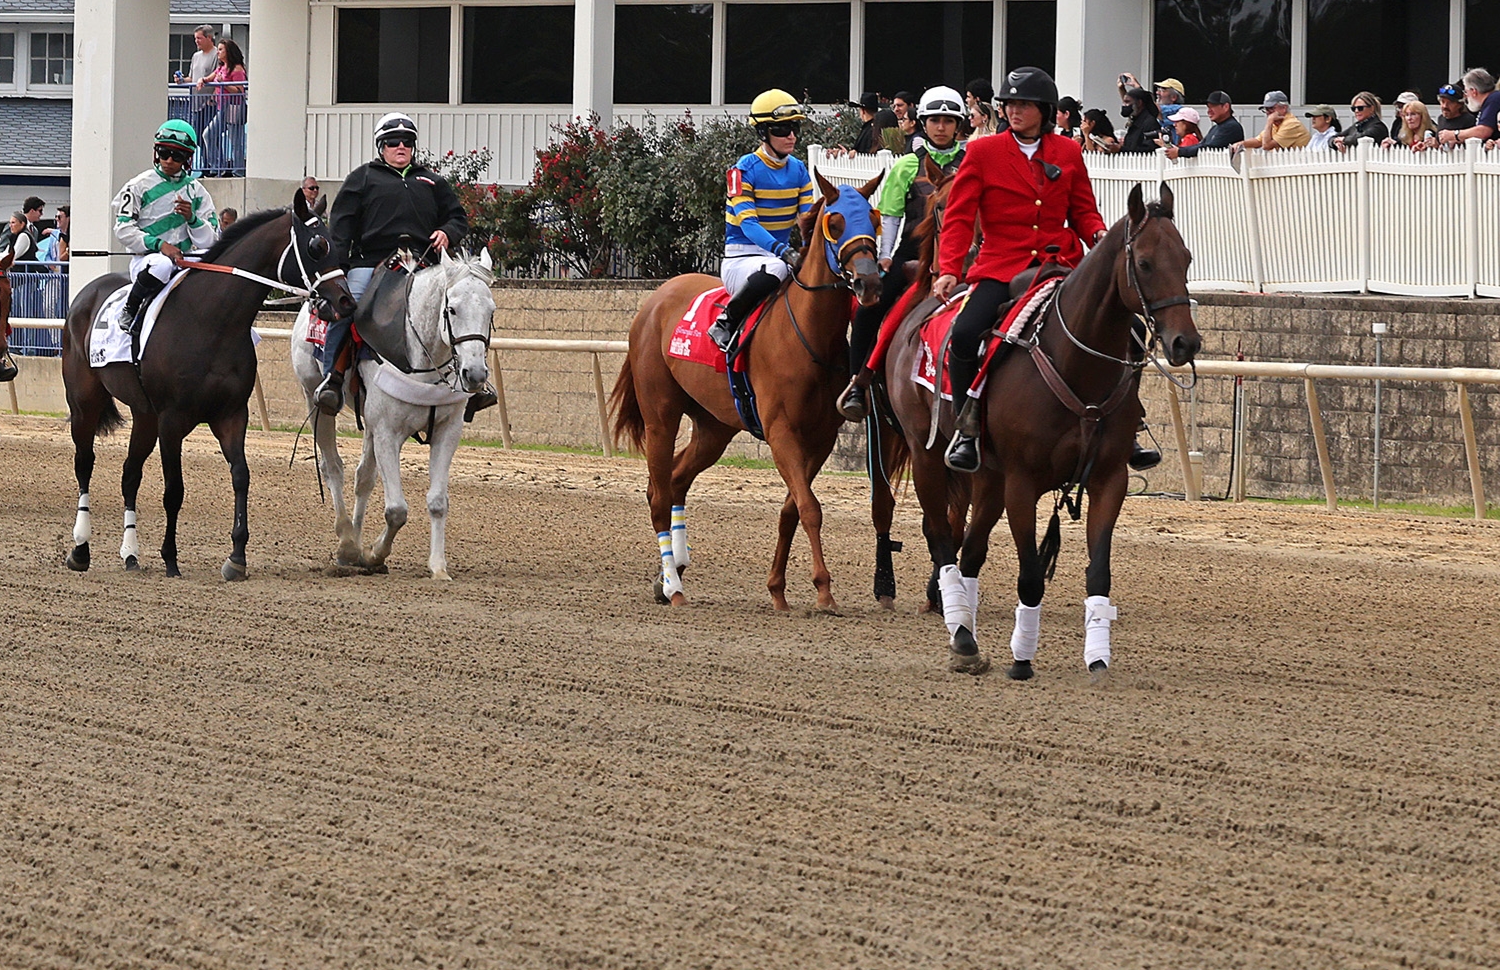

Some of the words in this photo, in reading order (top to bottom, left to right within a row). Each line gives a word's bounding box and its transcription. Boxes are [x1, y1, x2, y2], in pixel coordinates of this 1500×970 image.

[731, 170, 737, 194] 1
[120, 193, 131, 214] 2
[683, 286, 726, 322] 1
